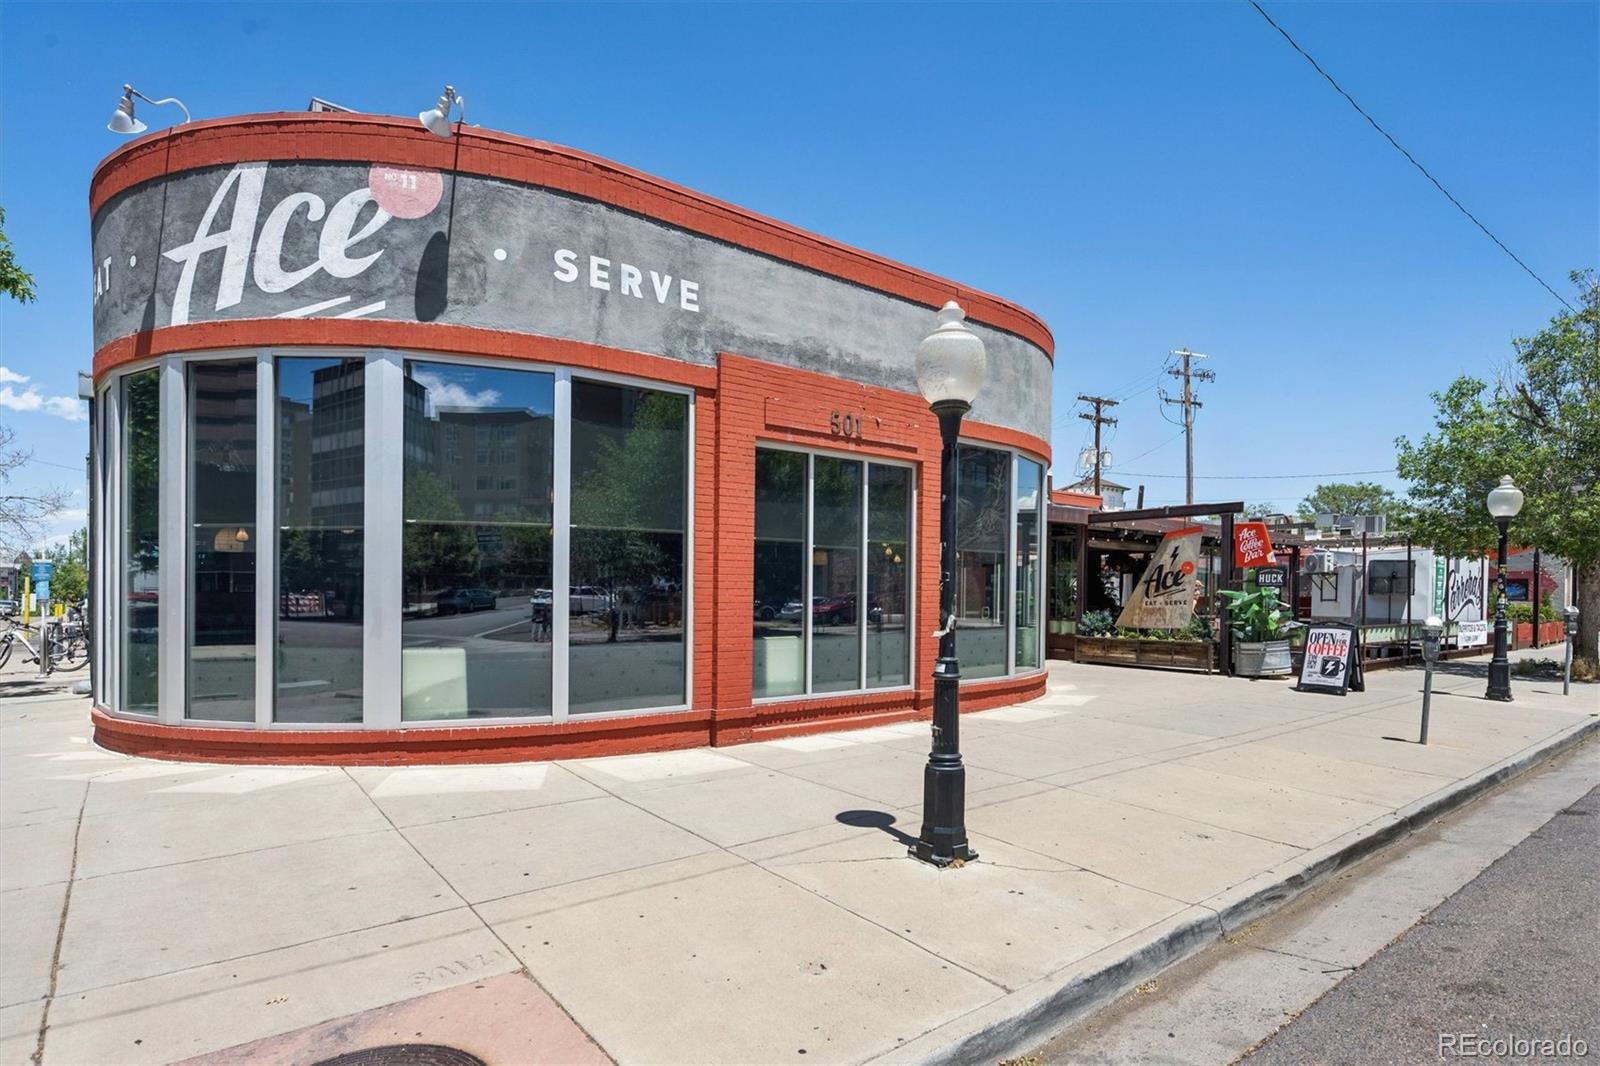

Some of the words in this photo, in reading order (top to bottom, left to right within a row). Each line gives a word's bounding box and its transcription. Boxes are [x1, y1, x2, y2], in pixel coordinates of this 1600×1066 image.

[400, 173, 416, 190] 11
[162, 161, 392, 326] Ace
[553, 248, 700, 313] SERVE
[831, 410, 864, 440] 501
[1239, 528, 1257, 541] Ace
[1240, 539, 1264, 553] Coffee
[1244, 550, 1264, 563] Bar
[1143, 564, 1186, 599] Ace
[1258, 574, 1283, 583] HUCK
[1310, 632, 1337, 644] OPEN
[1308, 643, 1346, 657] COFFEE
